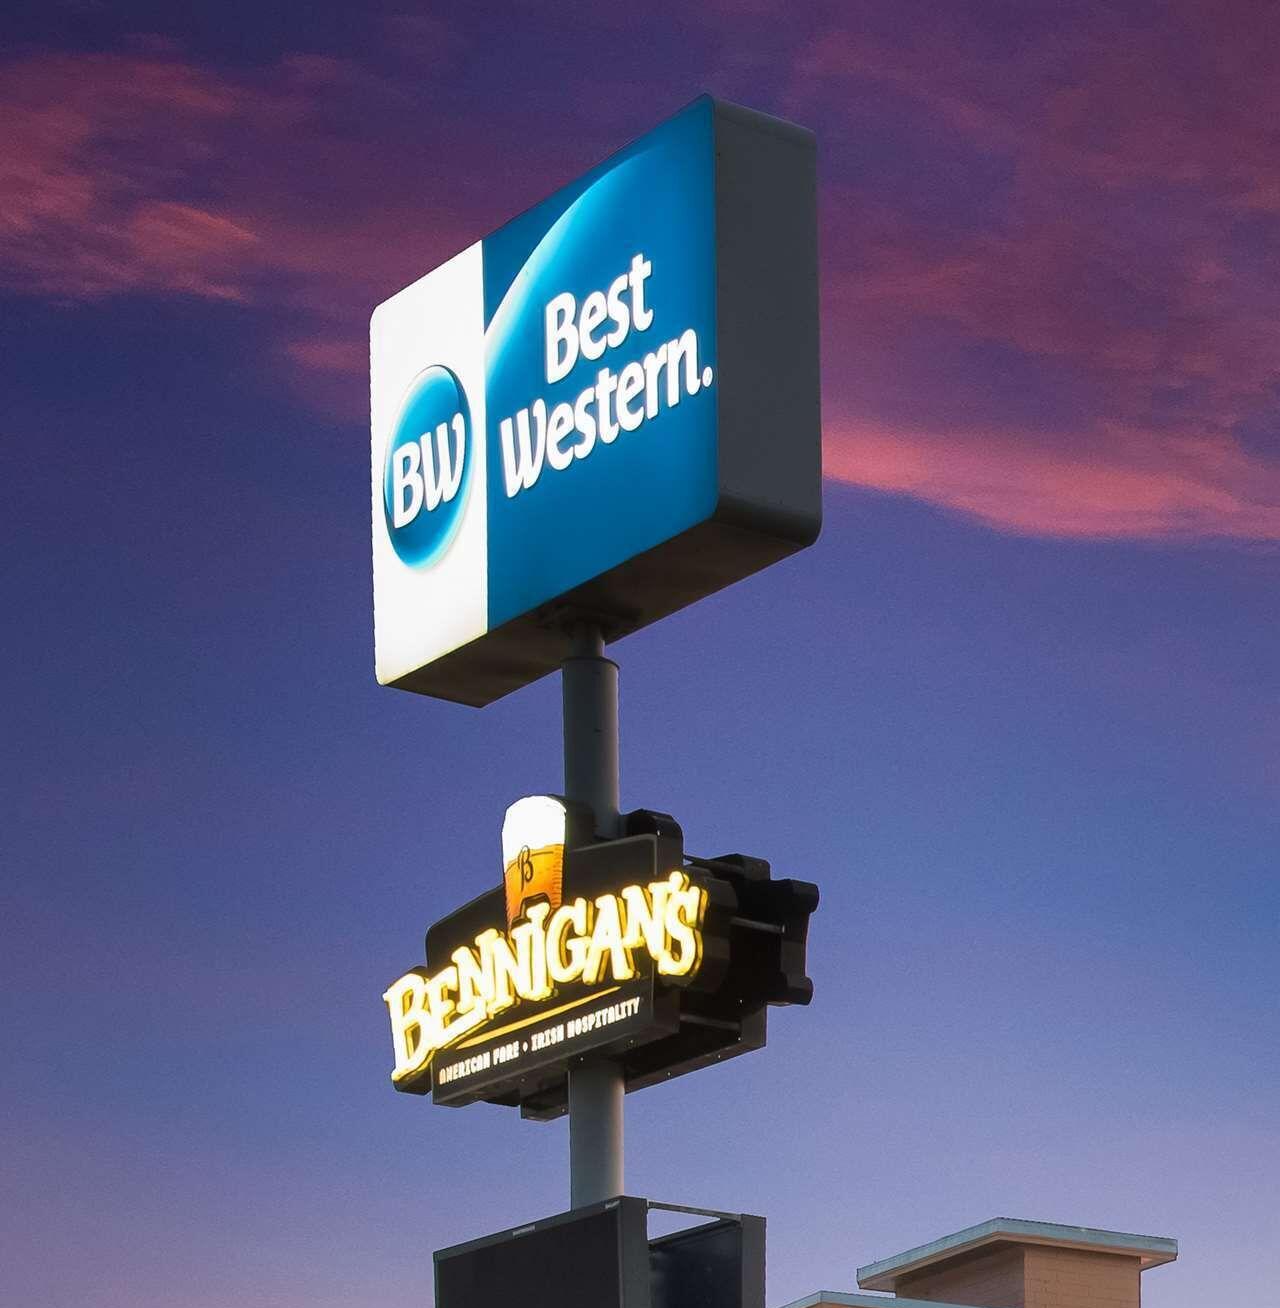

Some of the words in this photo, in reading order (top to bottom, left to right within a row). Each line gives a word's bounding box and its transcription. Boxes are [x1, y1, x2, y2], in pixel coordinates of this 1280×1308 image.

[545, 252, 654, 384] Best
[392, 412, 466, 528] BW
[382, 871, 704, 1081] BENNIGAN'S
[439, 1052, 490, 1085] AMERICAN
[493, 1041, 520, 1065] FARE
[531, 1024, 565, 1051] IRISH
[567, 997, 641, 1038] HOSPITALITY
